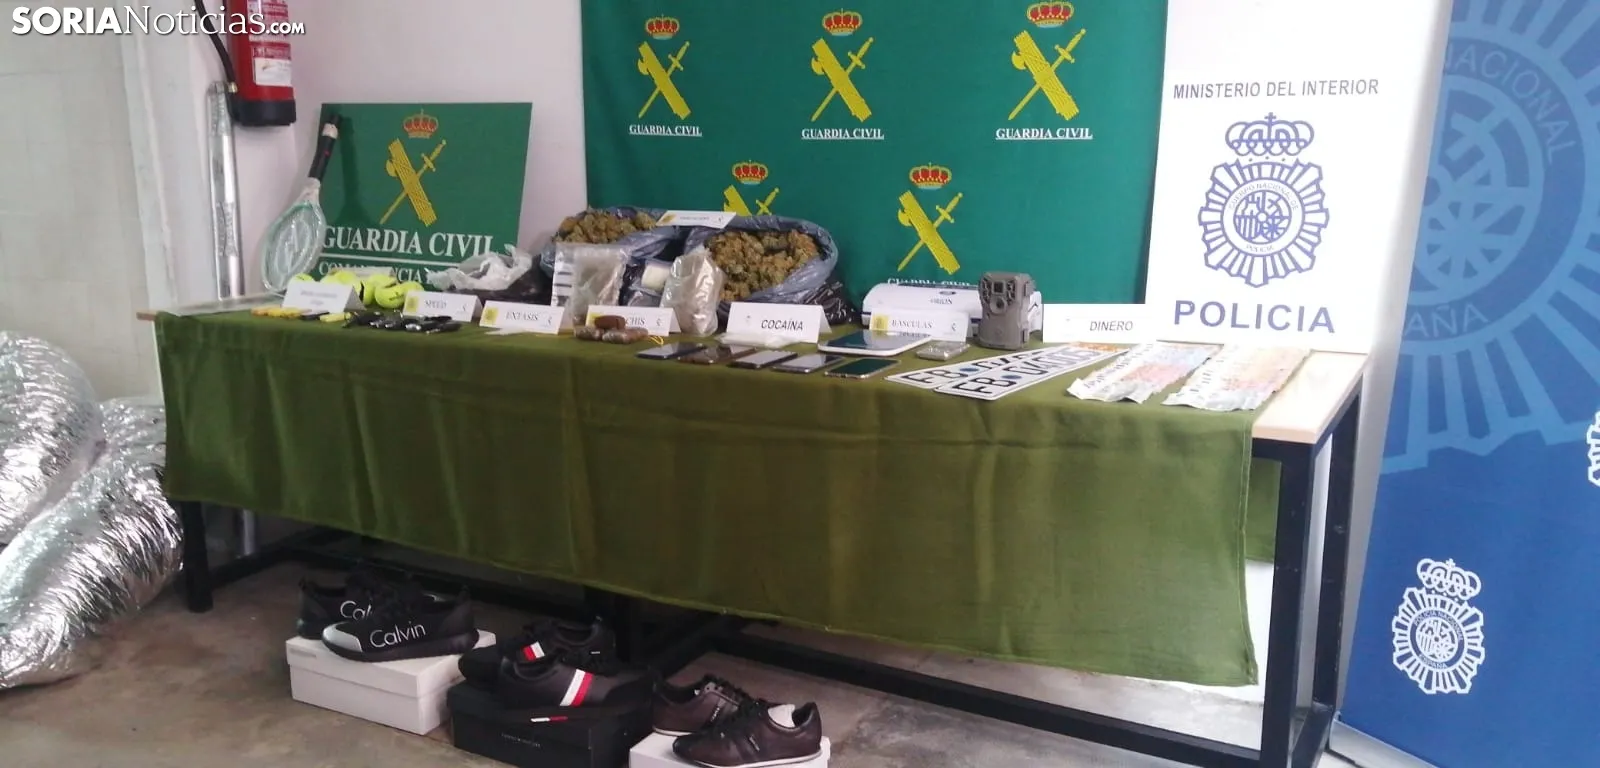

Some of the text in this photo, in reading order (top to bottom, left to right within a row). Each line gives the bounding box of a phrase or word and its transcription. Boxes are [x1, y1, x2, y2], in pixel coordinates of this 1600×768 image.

[1173, 79, 1379, 99] MINISTERIO DEL INTERIOR
[629, 124, 703, 137] GUARDIA CIVIL
[801, 128, 884, 140] GUARDIA CIVIL
[995, 127, 1093, 140] GUARDIA CIVIL
[322, 226, 494, 258] GUARDIA CIVIL
[424, 299, 447, 310] SPEED
[626, 316, 646, 326] CHIS
[1173, 299, 1336, 334] POLICIA
[1404, 301, 1490, 338] AÑA
[760, 318, 804, 331] COCAÍNA
[1089, 320, 1134, 332] DINERO
[952, 376, 1017, 394] FB
[339, 600, 373, 621] Cal
[369, 621, 427, 649] Calvin
